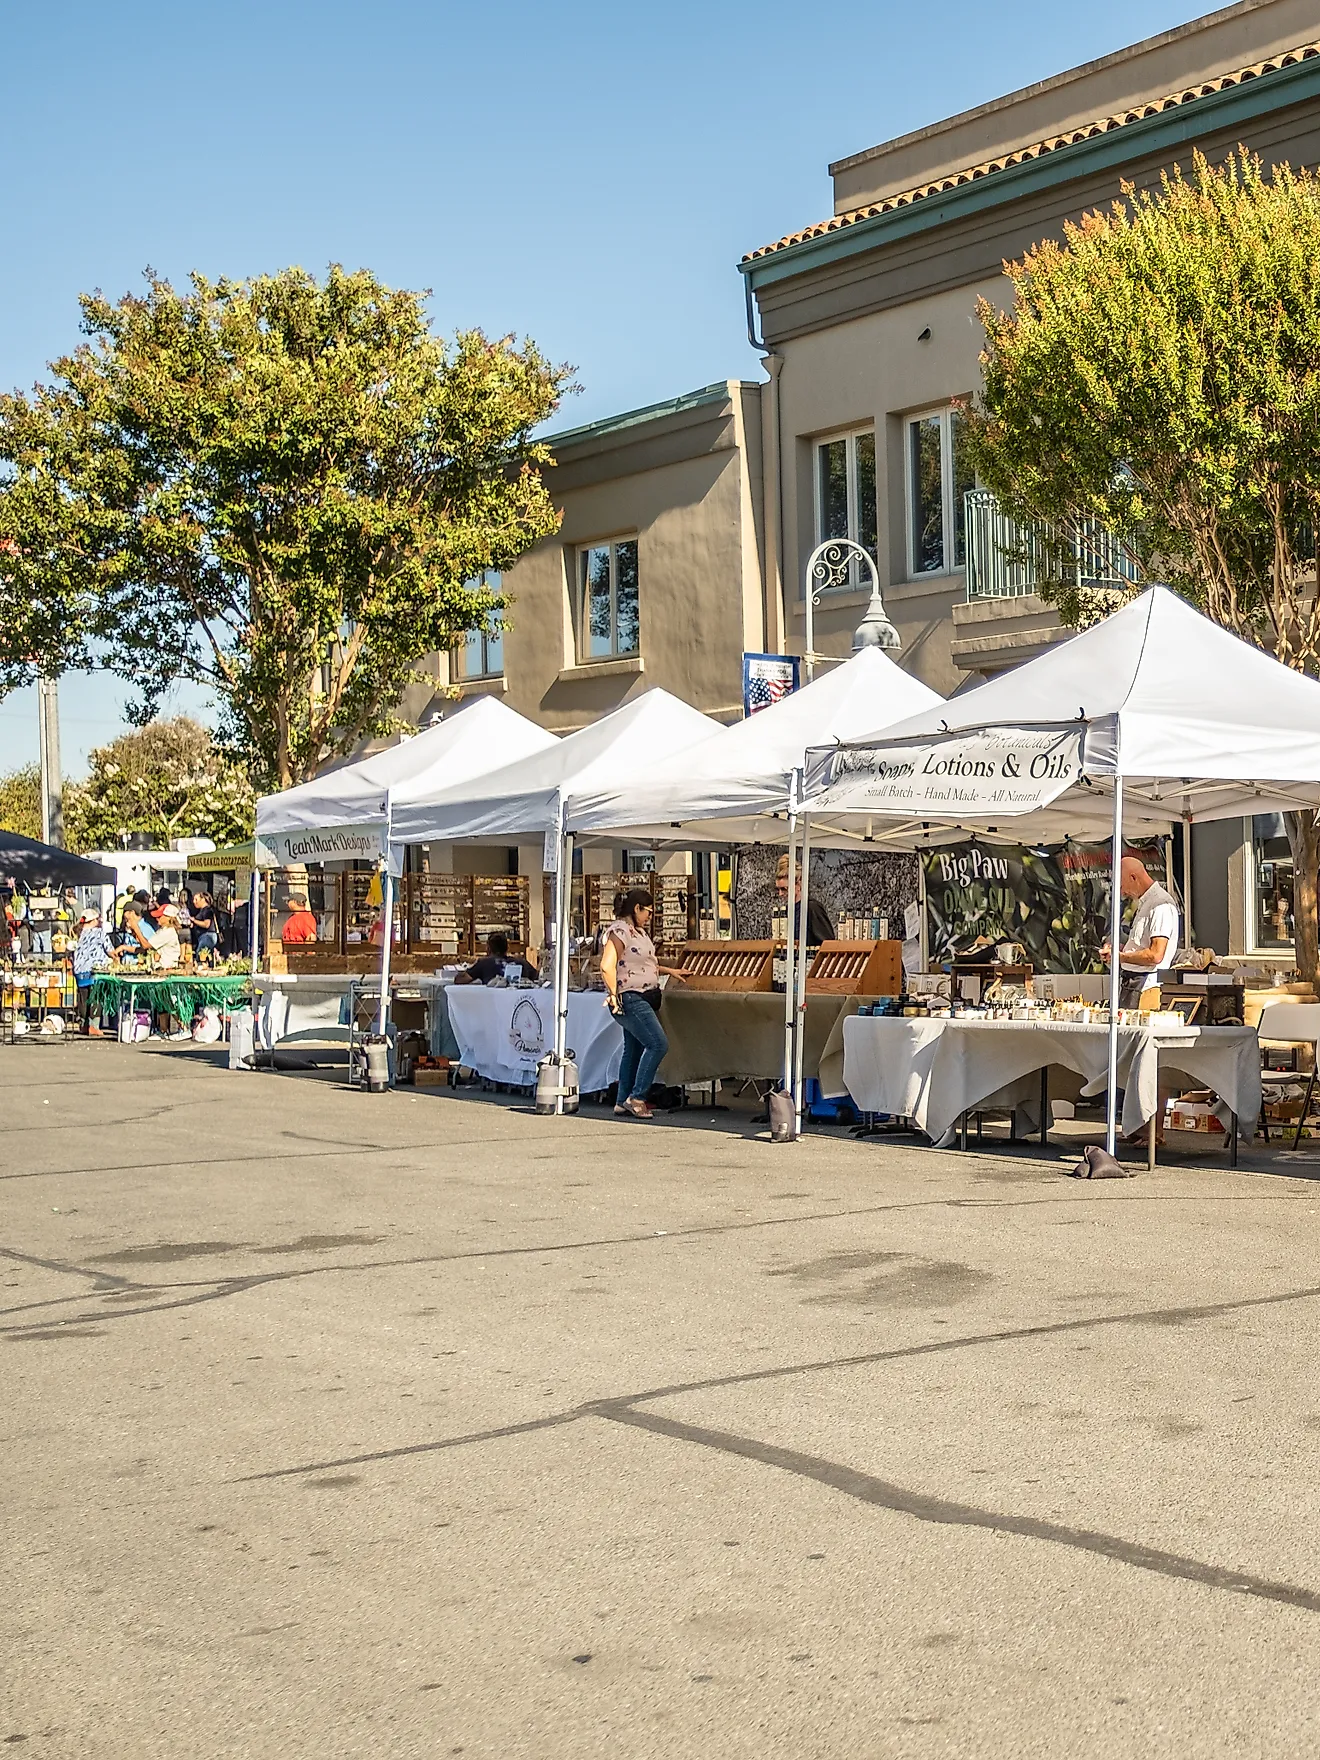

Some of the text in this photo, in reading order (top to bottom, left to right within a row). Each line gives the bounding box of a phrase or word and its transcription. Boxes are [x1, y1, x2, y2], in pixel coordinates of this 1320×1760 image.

[922, 753, 995, 777] Lotions
[1001, 753, 1022, 778] &
[1030, 753, 1072, 779] Oils
[866, 785, 888, 797] Small
[888, 784, 913, 798] Batch
[924, 787, 952, 800] Hand
[953, 788, 979, 801] Made
[988, 789, 1004, 801] All
[938, 848, 1009, 888] Big Paw
